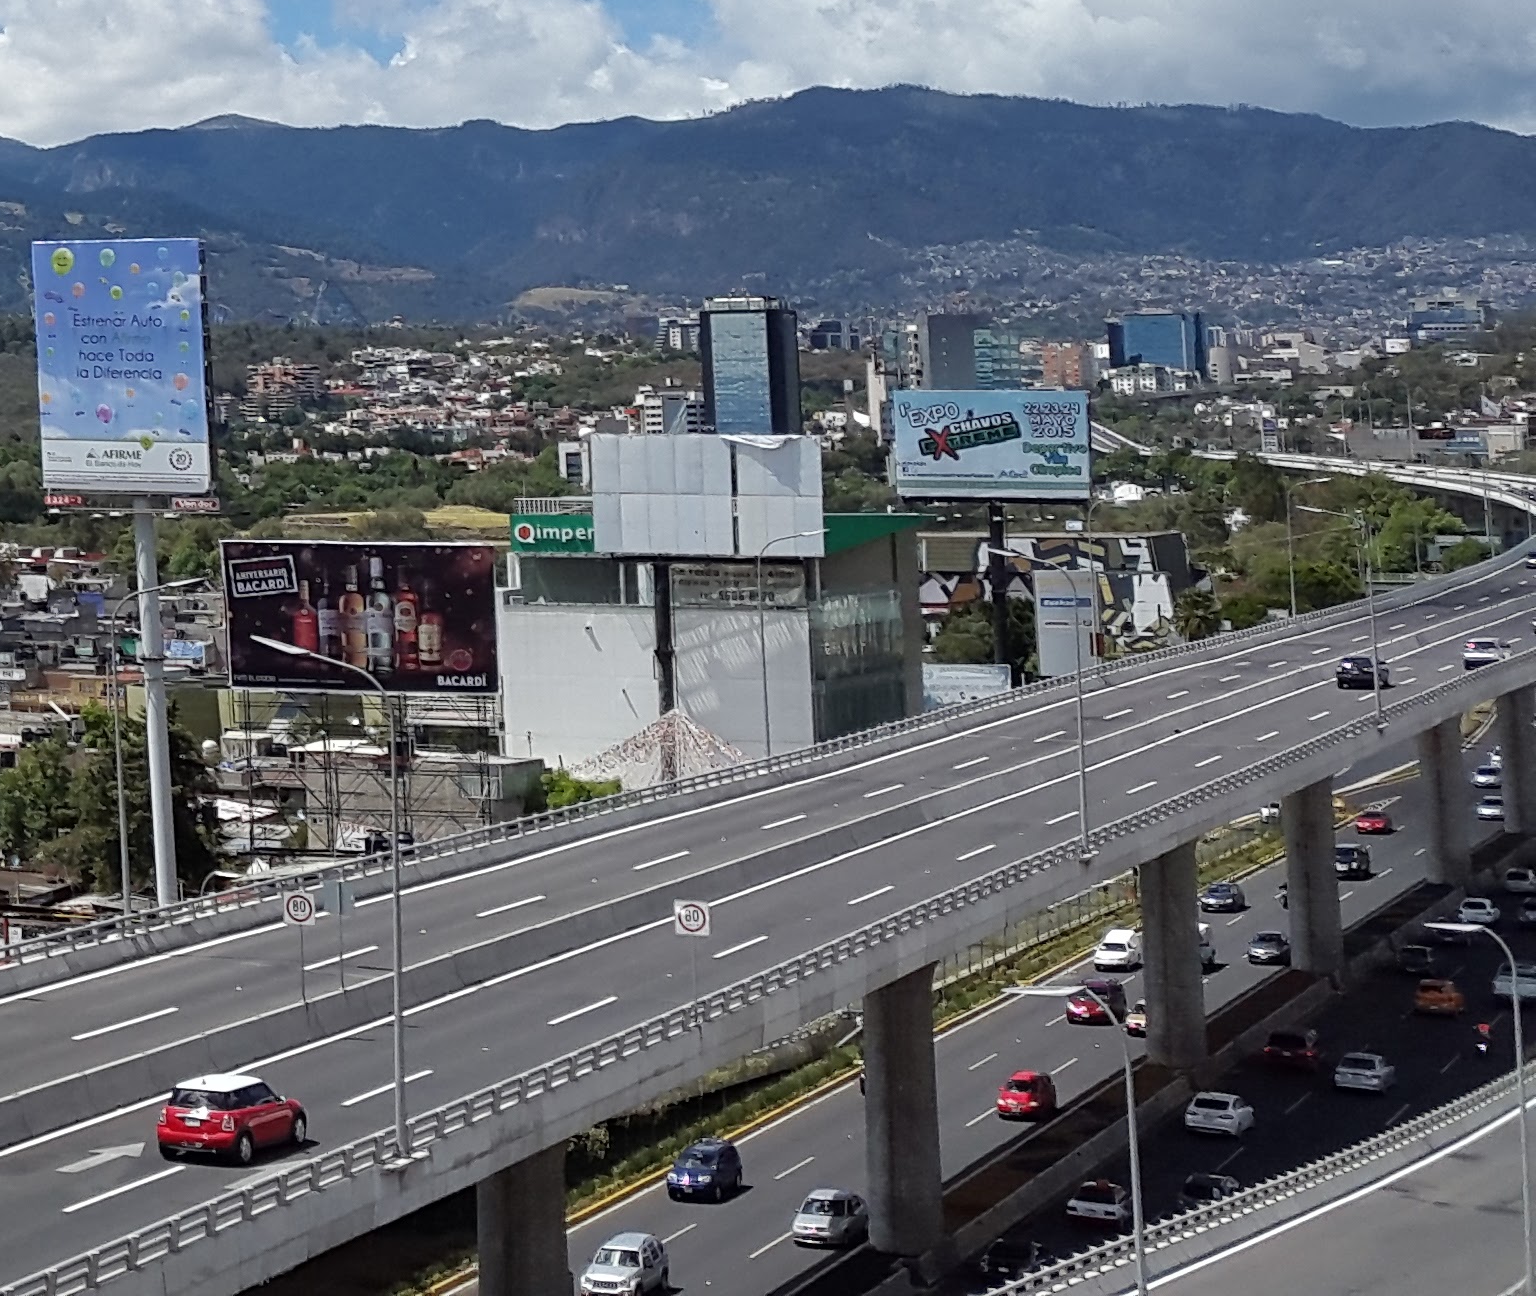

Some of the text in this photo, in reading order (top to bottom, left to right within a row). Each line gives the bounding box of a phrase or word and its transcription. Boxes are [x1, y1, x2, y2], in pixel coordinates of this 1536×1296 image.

[73, 313, 127, 327] Estrenar
[81, 334, 107, 345] con
[78, 348, 154, 362] hace Toda
[76, 365, 163, 379] la Diferencia
[908, 401, 960, 428] EXPO
[1029, 414, 1076, 425] MAYO
[948, 413, 1013, 434] CHAVOS
[1031, 425, 1076, 438] 2015
[101, 449, 142, 460] AFIRME
[236, 567, 287, 581] ANIVERSARIO
[292, 899, 306, 912] 80
[685, 909, 699, 922] 80
